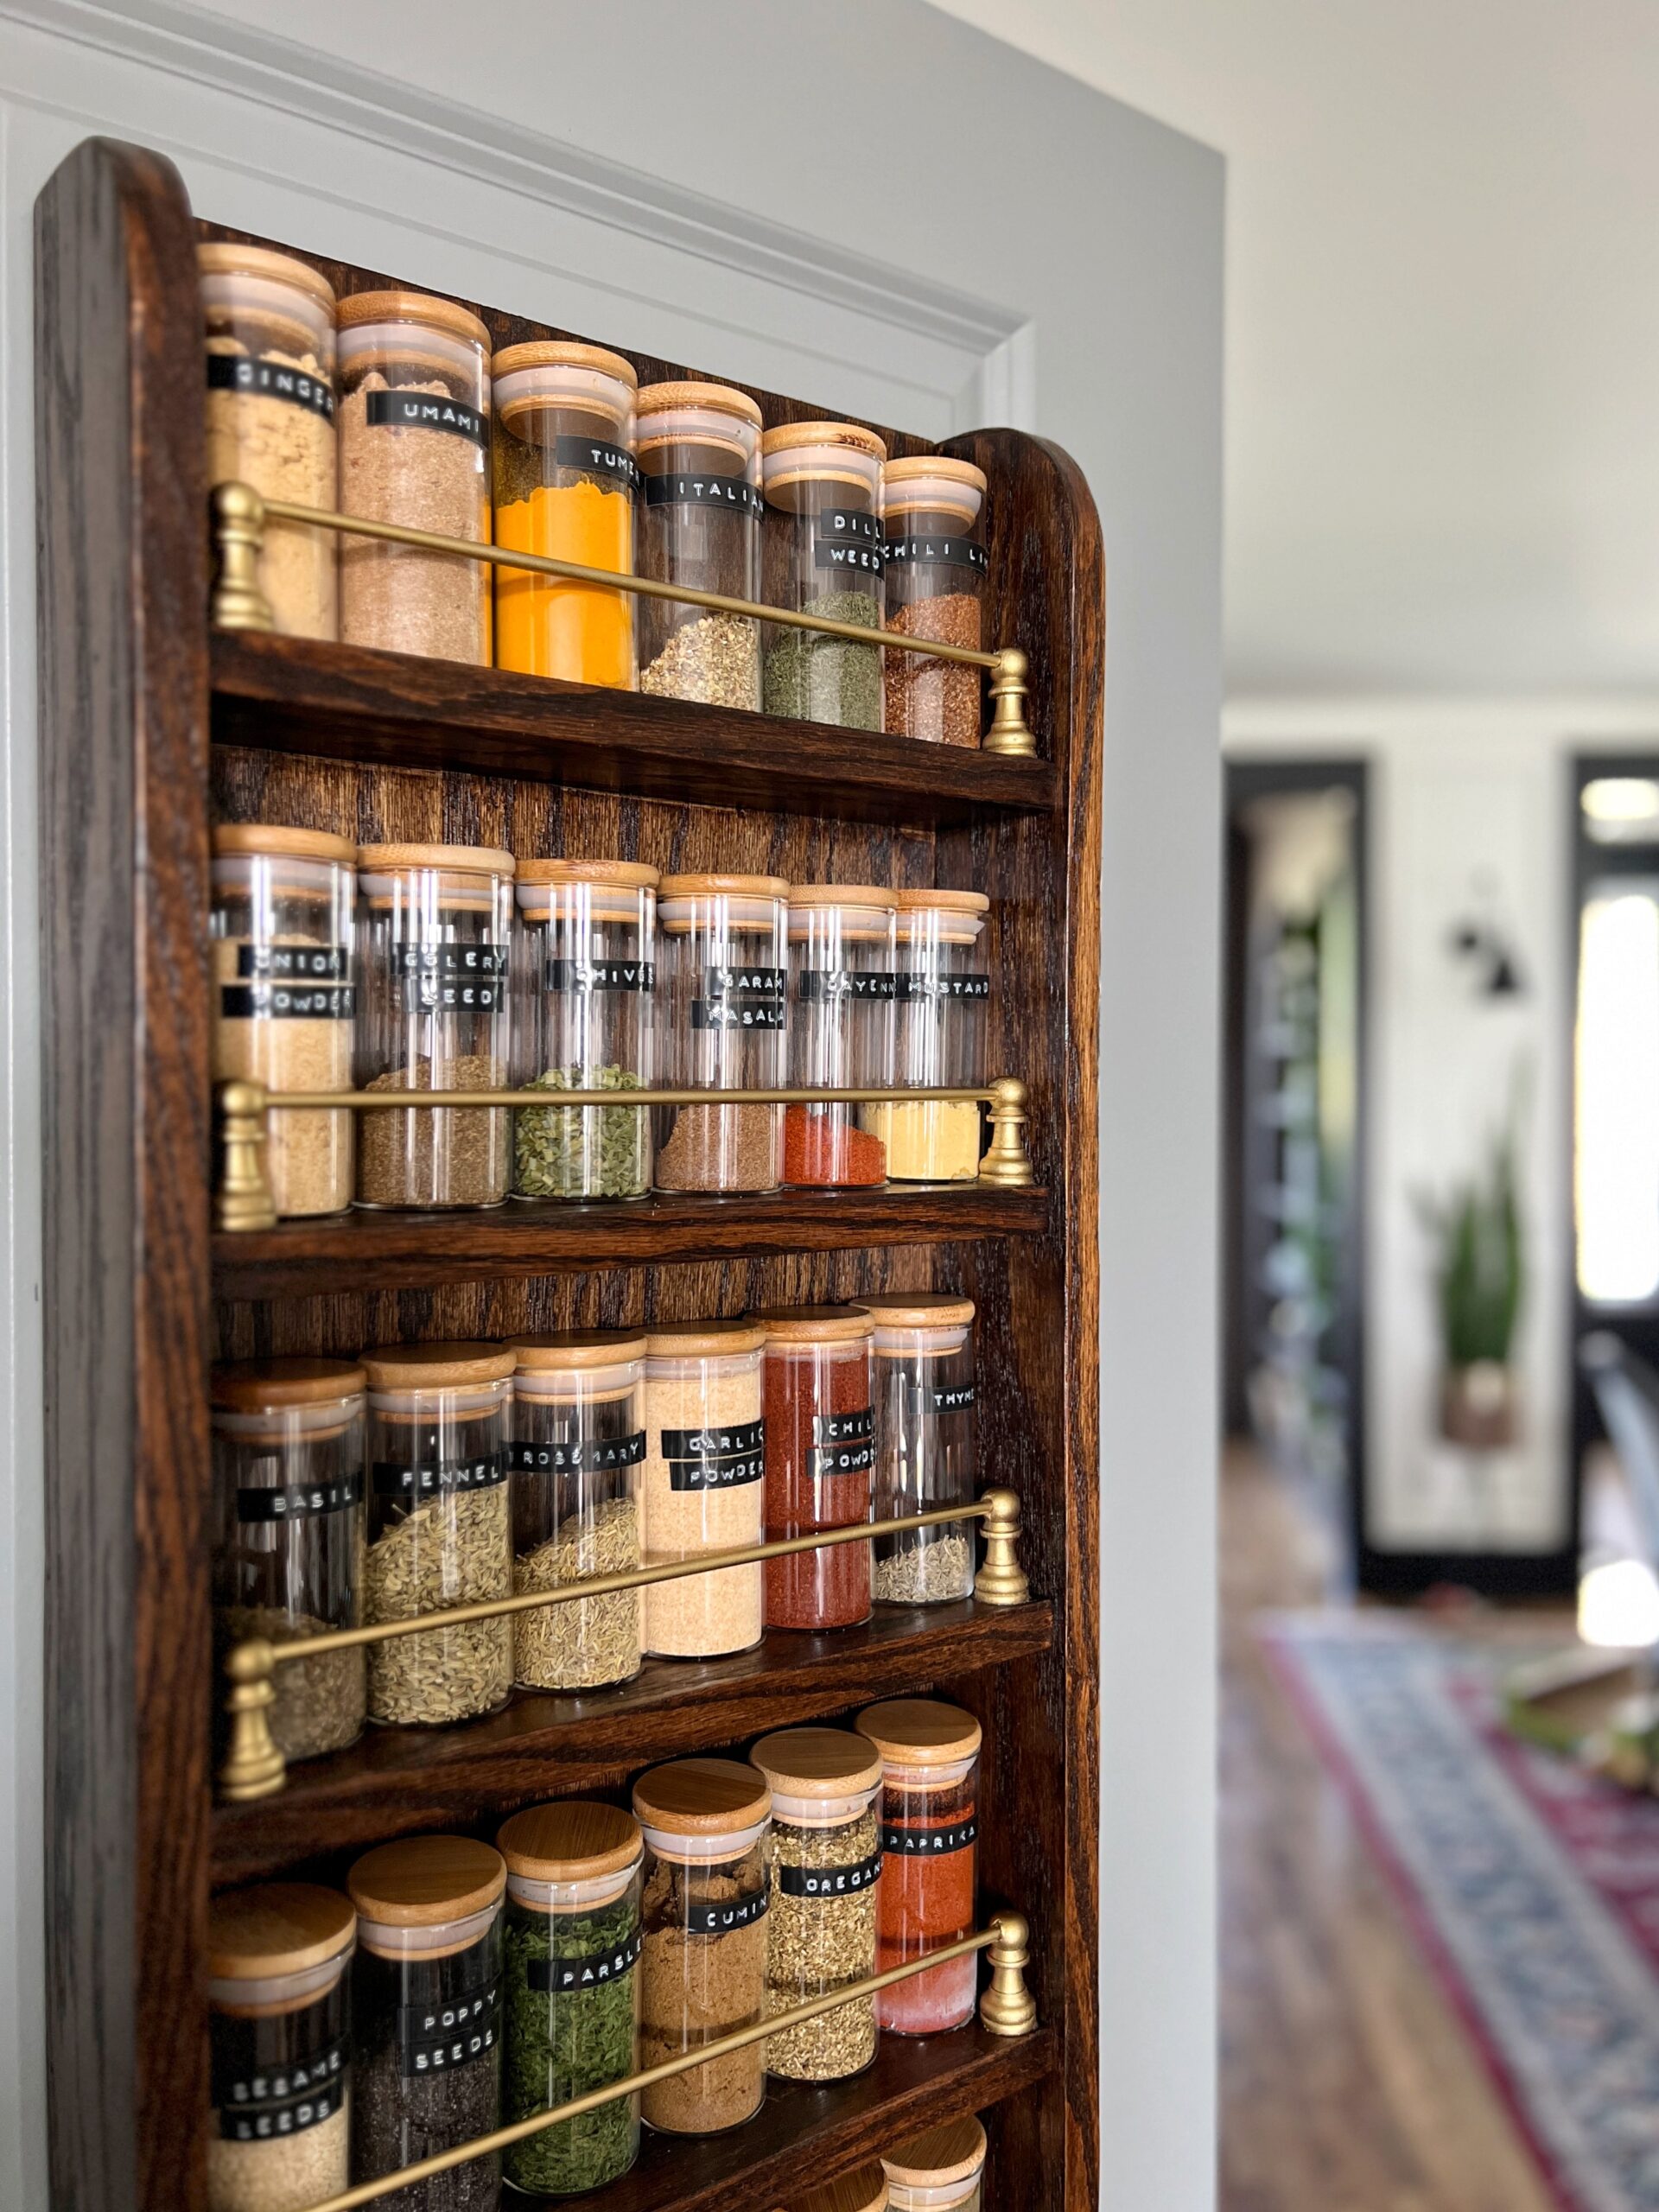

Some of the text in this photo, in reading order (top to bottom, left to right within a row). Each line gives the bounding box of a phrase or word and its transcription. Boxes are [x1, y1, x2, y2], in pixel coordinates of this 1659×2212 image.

[404, 403, 479, 433] UMAMI
[834, 515, 880, 538] DILL
[830, 549, 880, 570] WEED
[883, 543, 950, 559] CHILI
[256, 953, 340, 972] ONION
[722, 973, 783, 989] GARAM
[908, 981, 988, 995] MUSTARD
[421, 988, 492, 1005] SEED
[709, 1007, 784, 1025] MASALA
[403, 1465, 499, 1486] FENNEL
[273, 1486, 352, 1512] BASIL
[890, 1826, 975, 1848] PAPRIKA
[707, 1895, 767, 1928] CUMIN
[424, 1989, 496, 2031] POPPY
[416, 2030, 493, 2070] SEEDS
